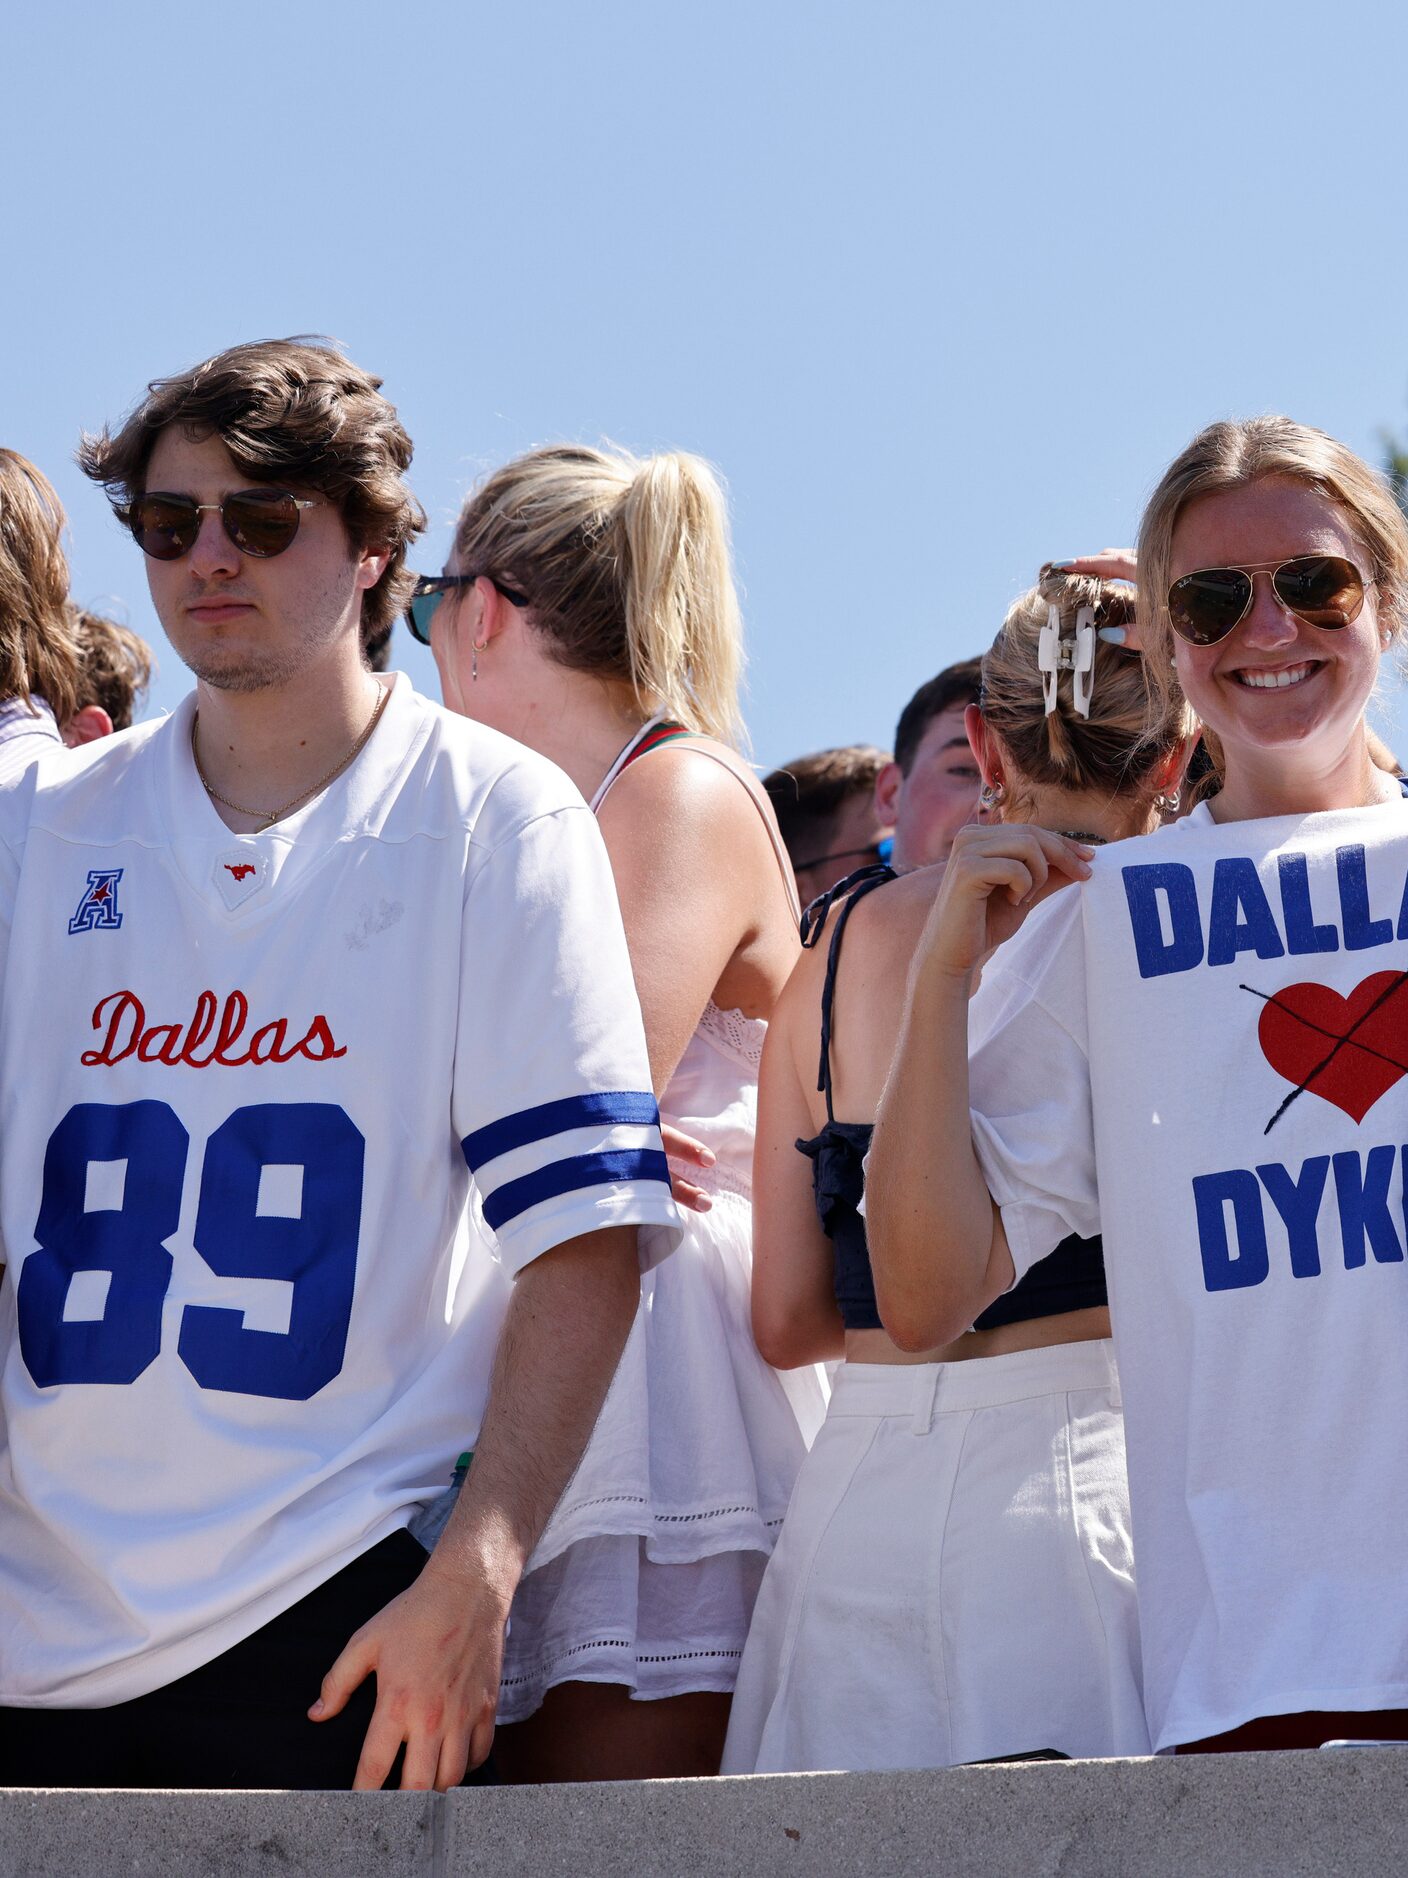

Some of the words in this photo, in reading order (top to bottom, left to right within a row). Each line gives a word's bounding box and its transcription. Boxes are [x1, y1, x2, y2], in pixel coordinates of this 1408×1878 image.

[68, 868, 124, 935] A
[81, 990, 347, 1069] Dallas
[17, 1099, 366, 1401] 89
